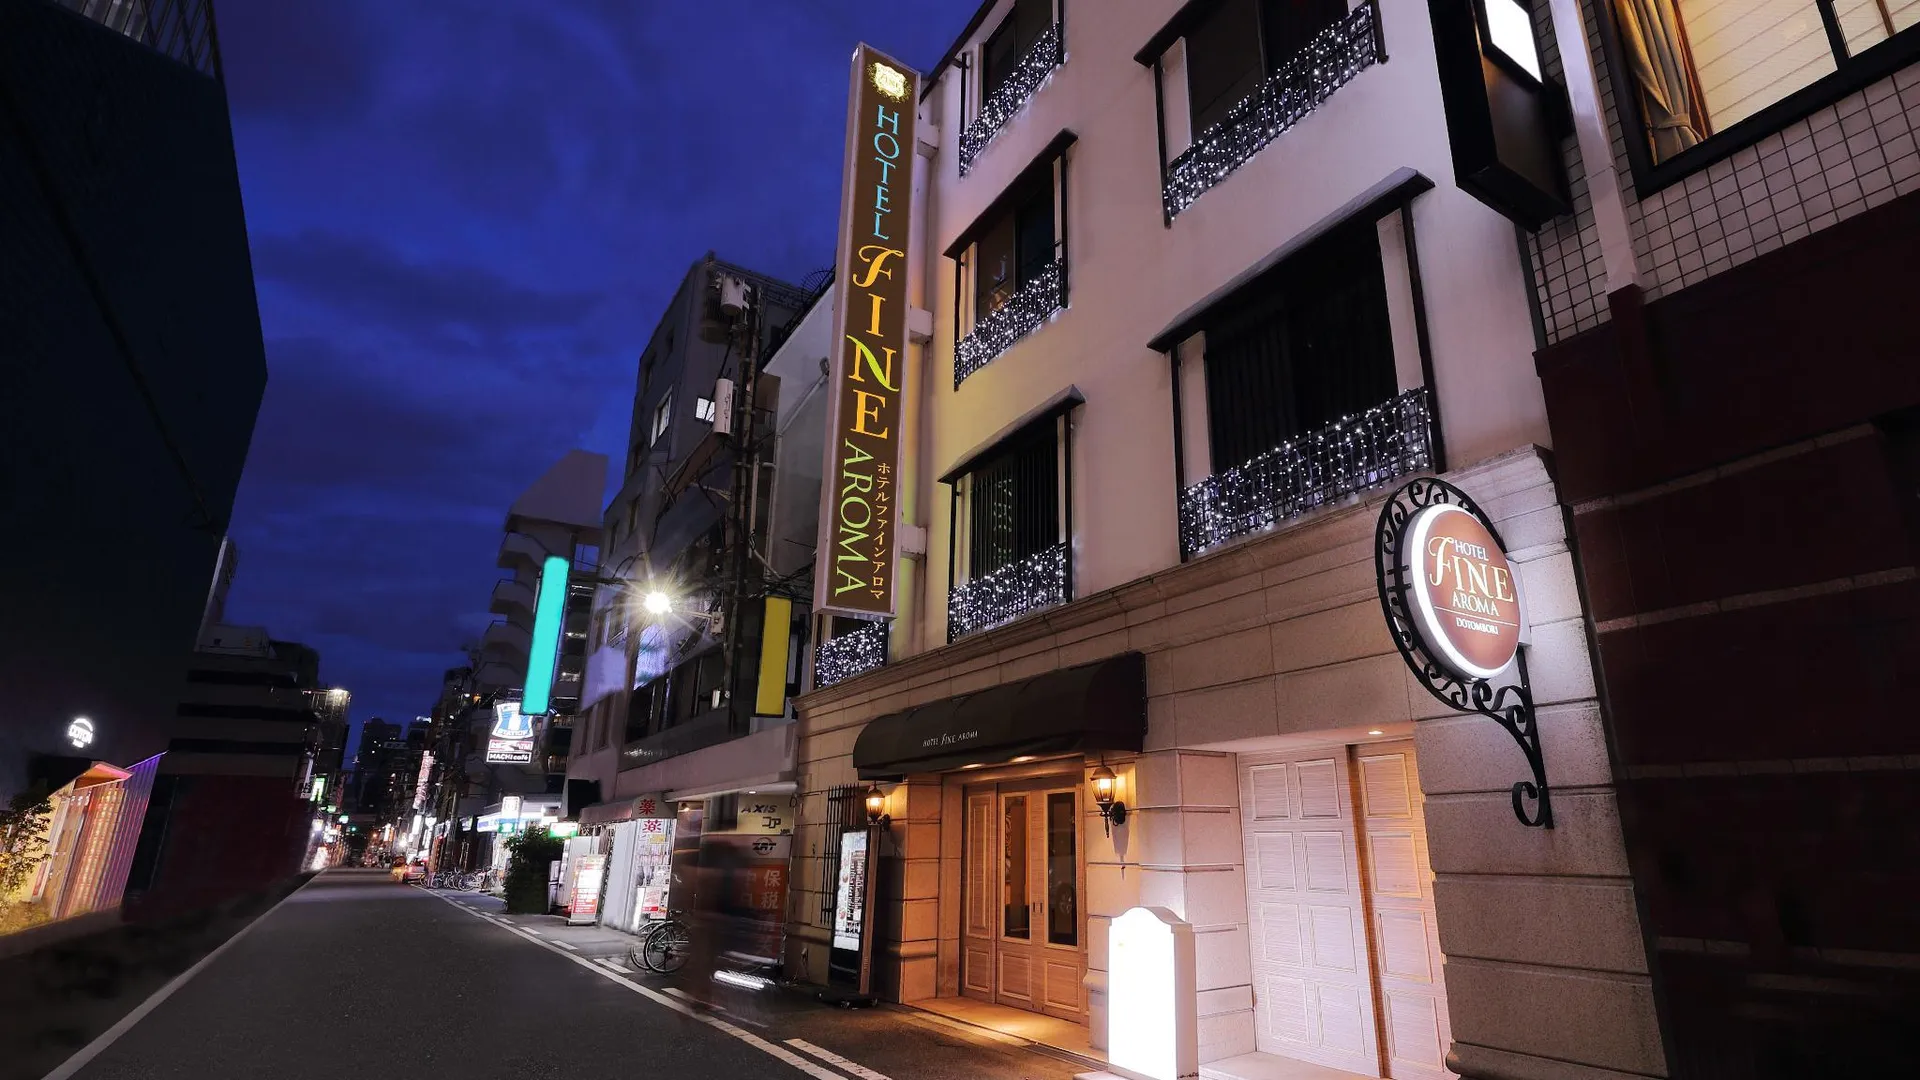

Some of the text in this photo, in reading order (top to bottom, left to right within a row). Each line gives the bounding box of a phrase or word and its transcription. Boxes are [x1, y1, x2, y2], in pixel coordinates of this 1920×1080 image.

[873, 104, 900, 240] HOTEL
[845, 245, 904, 440] FINE
[835, 437, 874, 598] AROMA
[870, 462, 890, 600] ホテルファインアロマ
[1455, 540, 1489, 561] HOTEL
[1428, 536, 1514, 603] FINE
[1452, 591, 1500, 617] AROMA
[639, 799, 656, 815] 薬
[741, 804, 778, 813] AXIS
